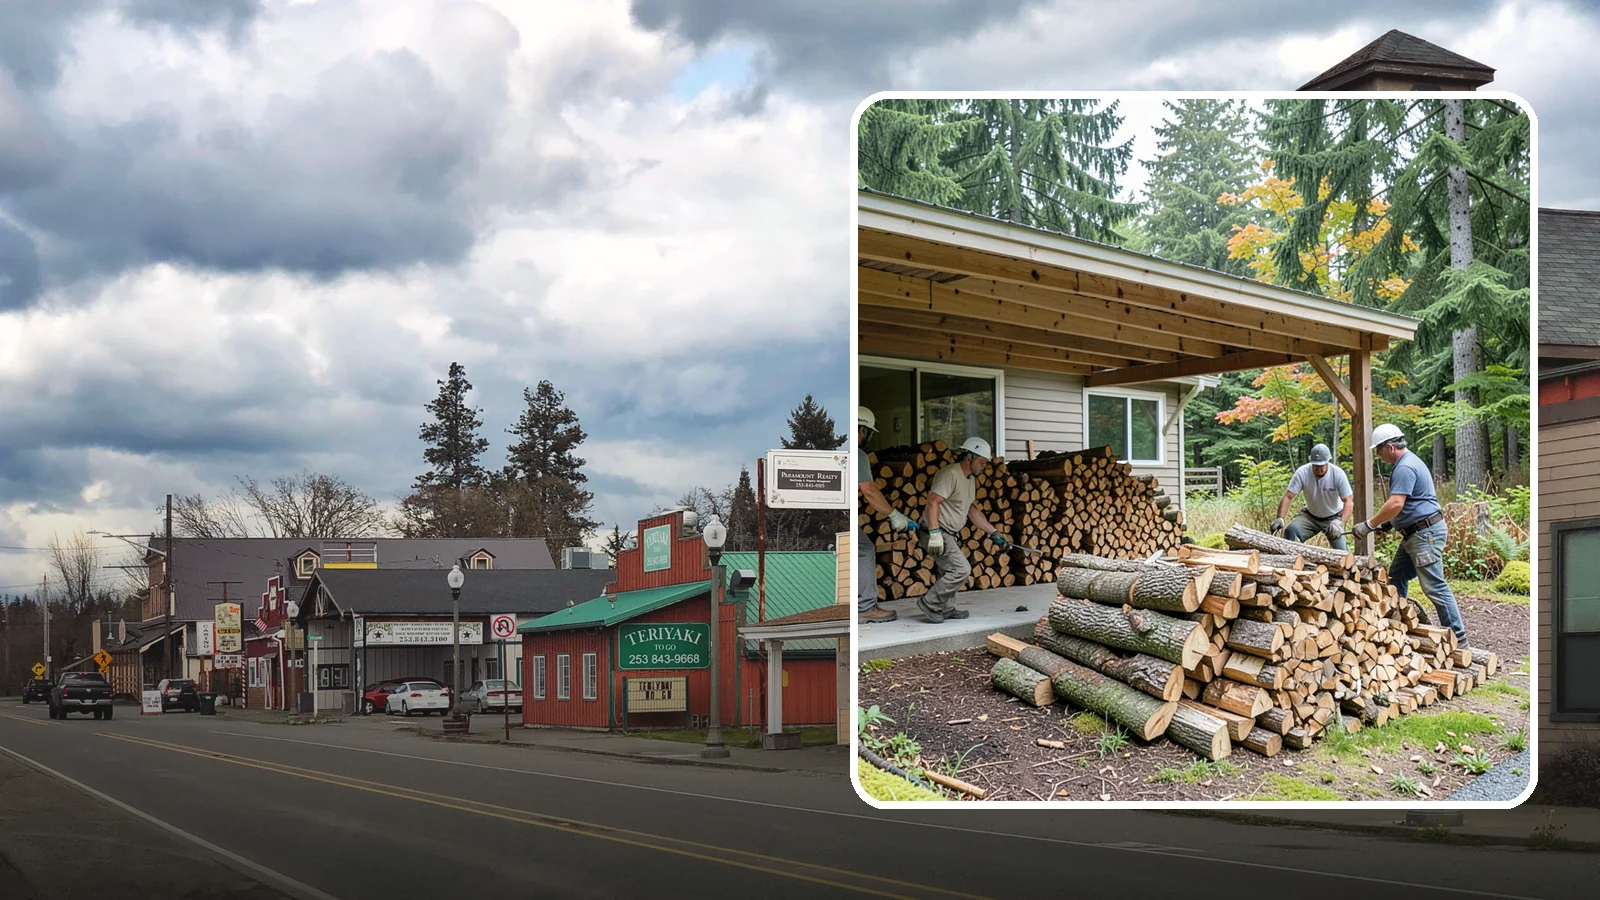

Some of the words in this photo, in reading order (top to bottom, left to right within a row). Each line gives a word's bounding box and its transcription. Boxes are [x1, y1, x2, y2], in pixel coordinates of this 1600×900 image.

[817, 472, 839, 480] REALTY
[624, 627, 703, 646] TERIYAKI
[653, 643, 665, 651] TO
[665, 643, 677, 651] GO
[628, 654, 649, 665] 253
[651, 653, 700, 664] 843-9668
